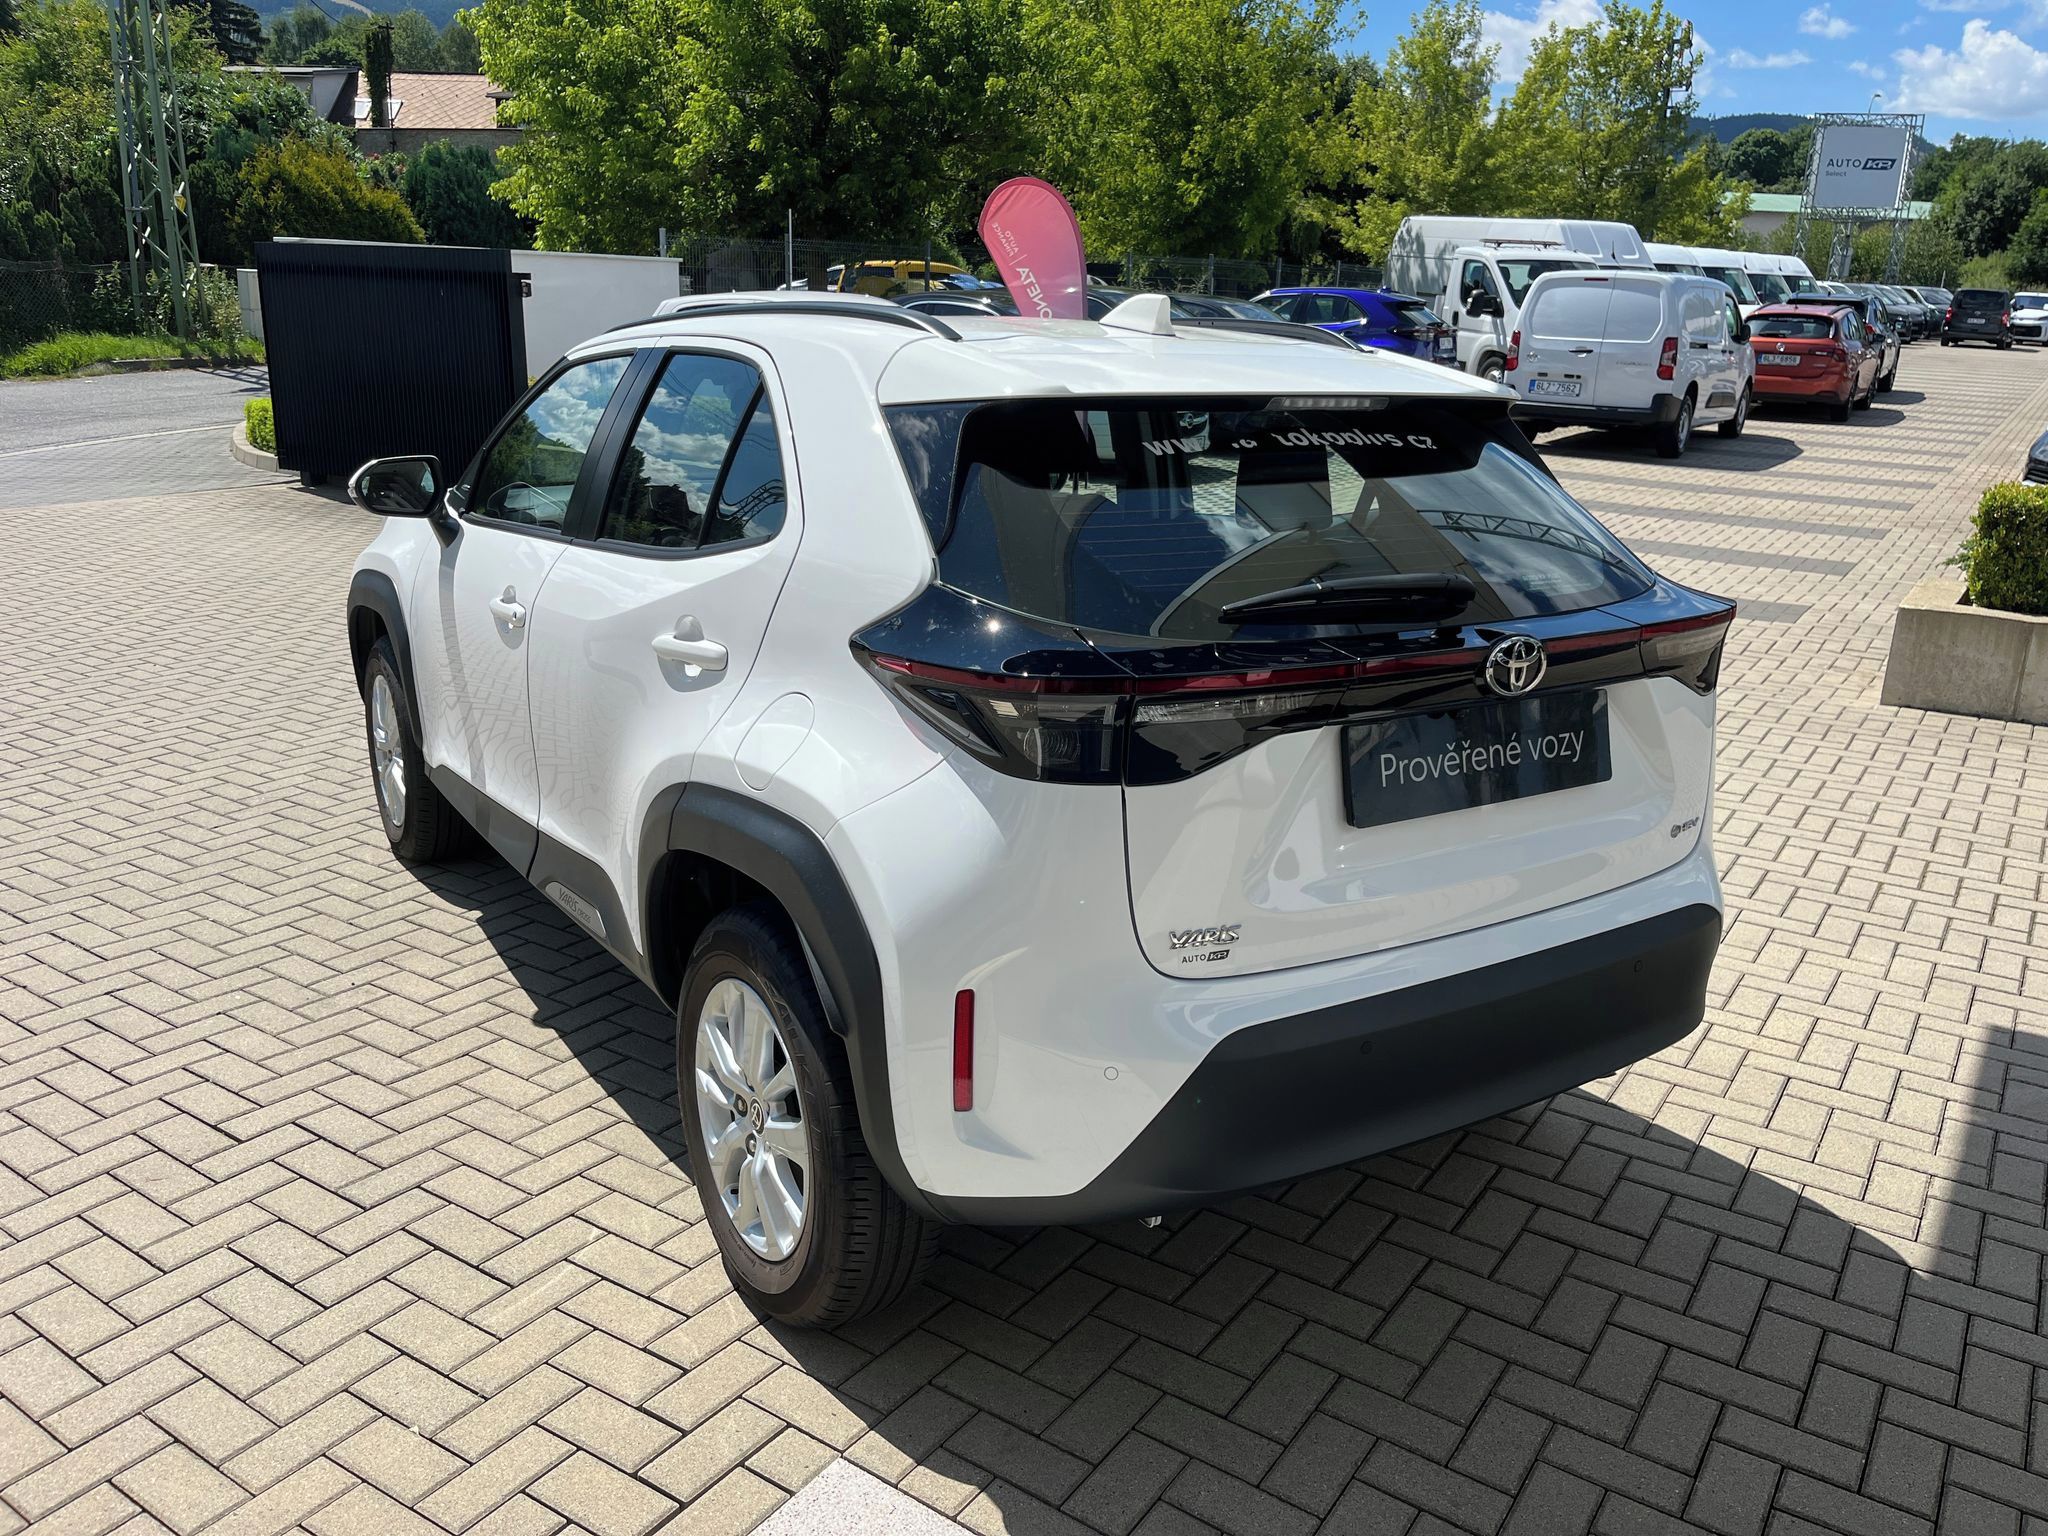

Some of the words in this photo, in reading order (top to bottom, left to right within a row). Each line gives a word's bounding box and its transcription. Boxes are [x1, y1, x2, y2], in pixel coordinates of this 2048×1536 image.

[1826, 158, 1862, 168] AUTO
[1380, 732, 1522, 788] Prověřené
[1527, 730, 1585, 763] vozy
[1168, 924, 1242, 949] YARIS
[1181, 953, 1207, 964] AUTO
